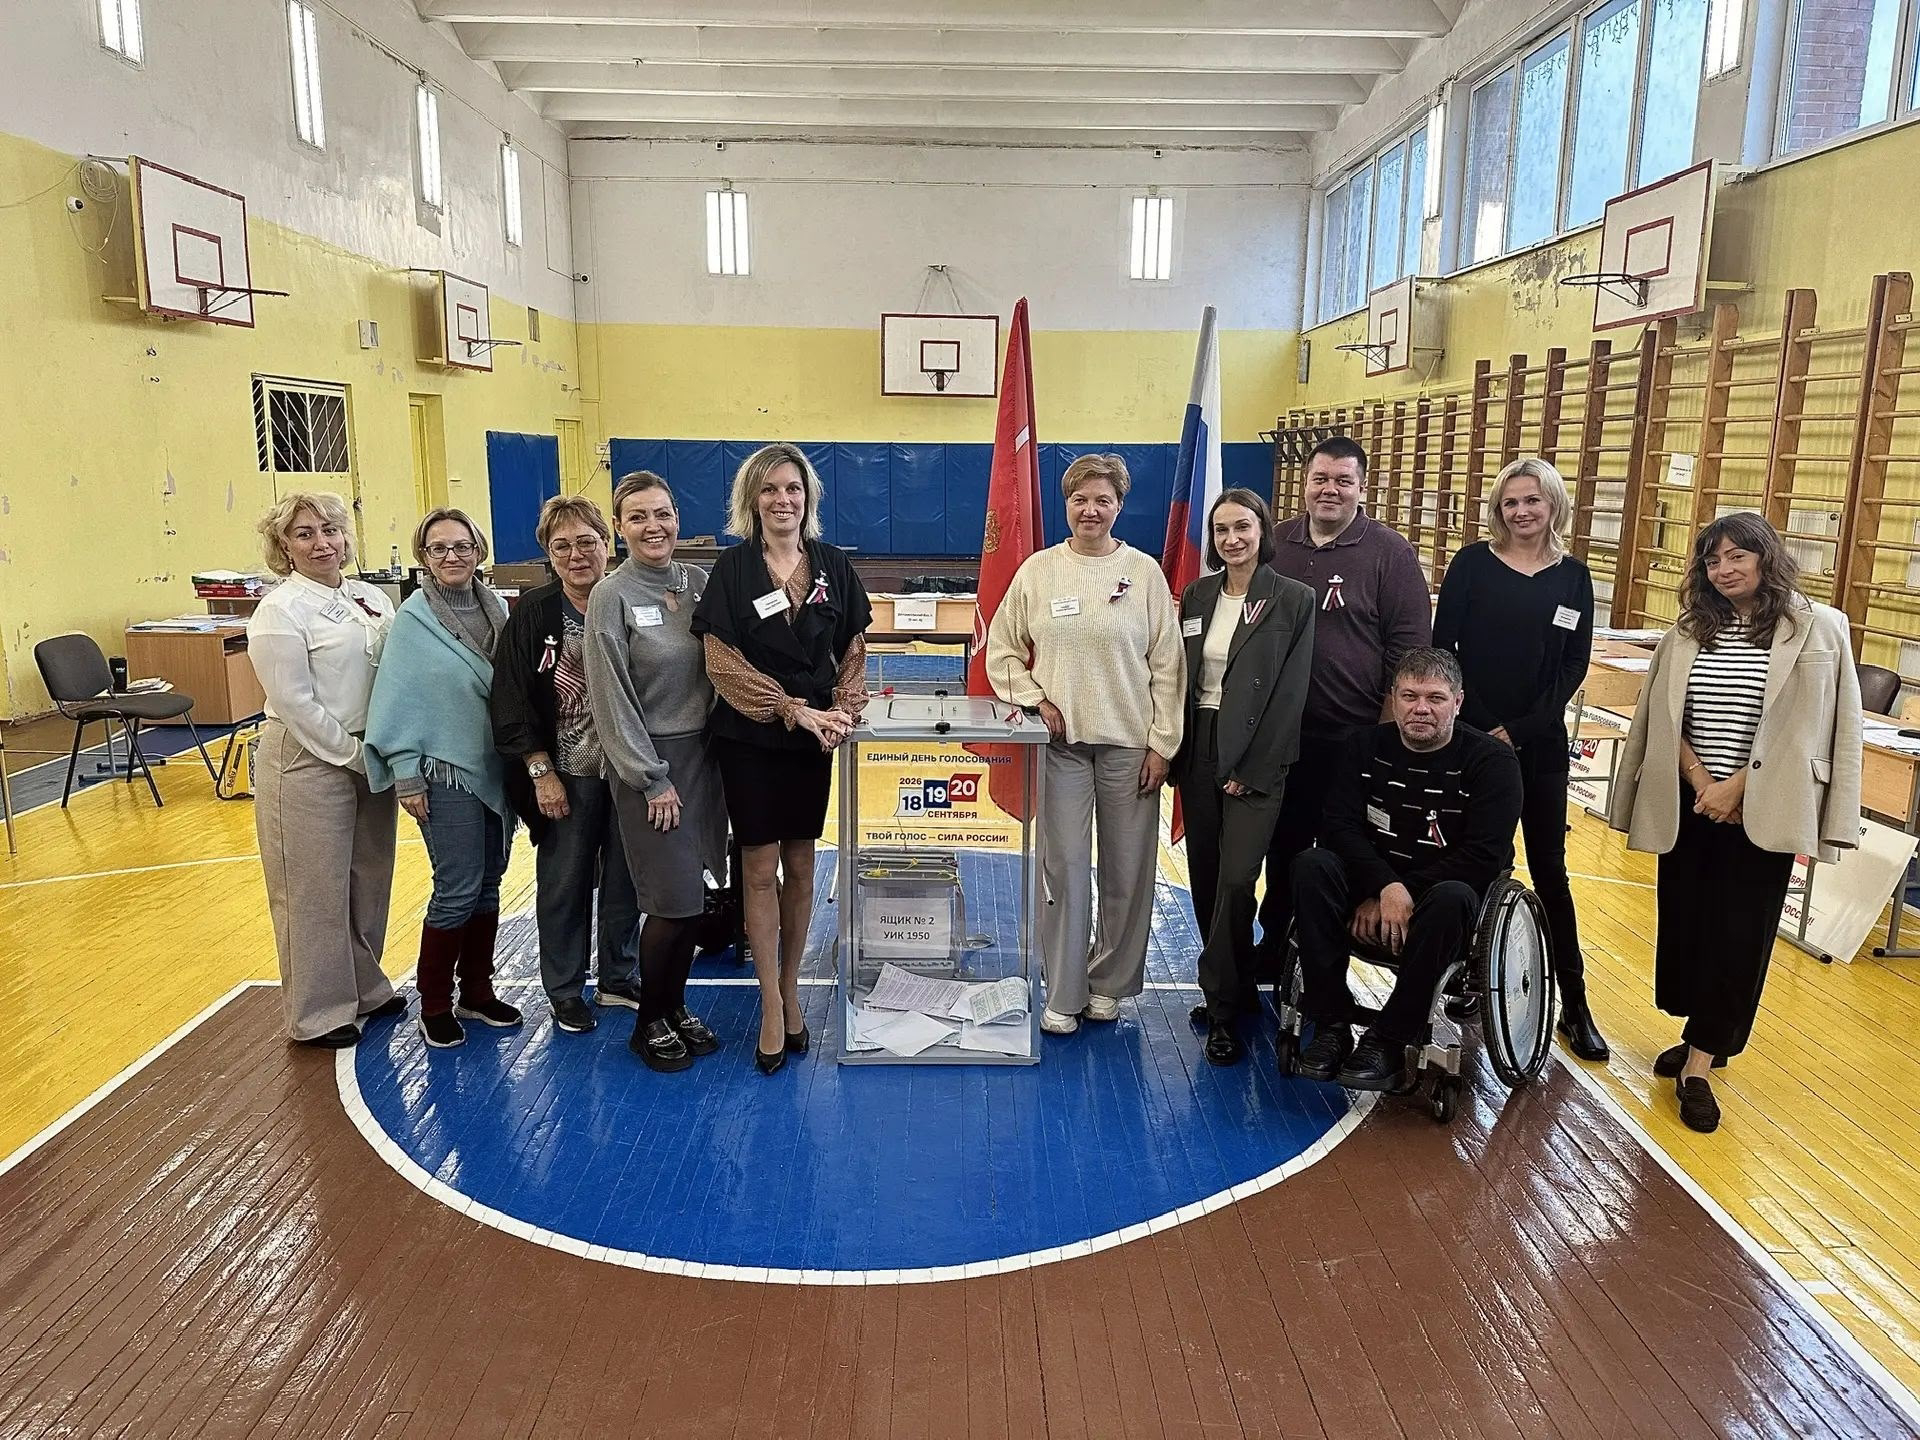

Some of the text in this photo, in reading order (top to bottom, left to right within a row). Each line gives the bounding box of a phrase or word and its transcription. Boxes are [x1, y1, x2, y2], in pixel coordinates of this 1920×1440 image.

[1572, 740, 1598, 754] 19 20
[866, 752, 1012, 764] ЕДИНЫЙ ДЕНЬ ГОЛОСОВАНИЯ
[1569, 759, 1591, 774] ЕНТЯБРЯ
[899, 777, 922, 785] 2026
[902, 779, 976, 811] 18 19 20
[927, 810, 978, 819] СЕНТЯБРЯ
[865, 831, 893, 841] ТВОЙ
[894, 833, 927, 841] ГОЛОС
[937, 833, 964, 842] СИЛА
[966, 834, 1009, 843] РОССИИ!
[879, 915, 935, 926] ЯЩИК № 2
[883, 931, 930, 940] УИК 1950
